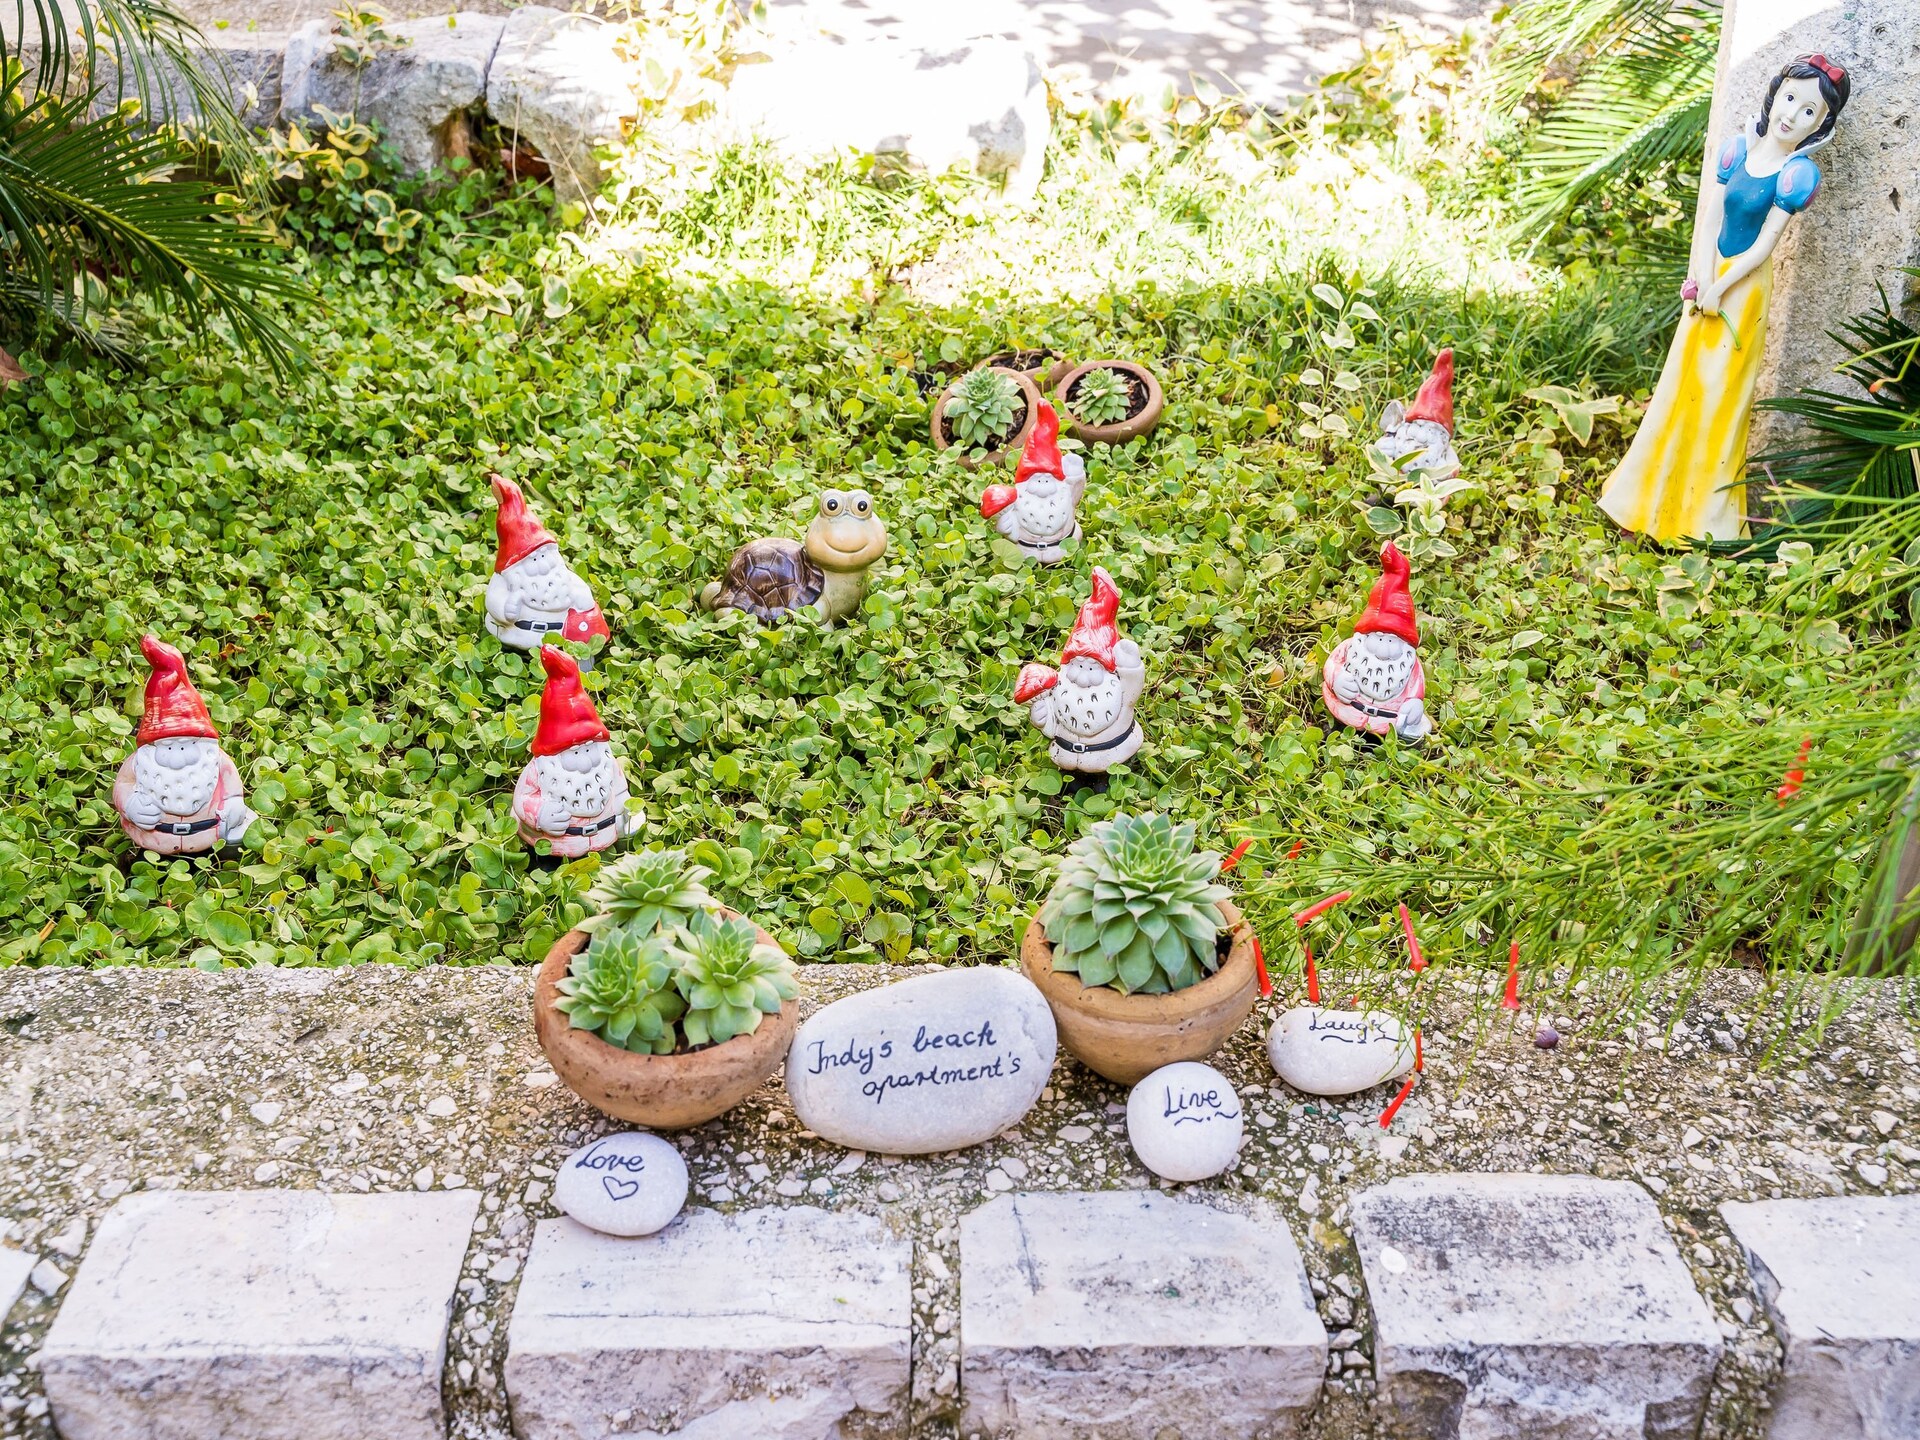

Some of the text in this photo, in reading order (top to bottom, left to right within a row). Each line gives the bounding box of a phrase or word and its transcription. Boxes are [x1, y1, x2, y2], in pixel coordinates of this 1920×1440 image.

[807, 1020, 997, 1075] Indy's beach
[862, 1051, 1021, 1104] apartment's
[1163, 1085, 1221, 1118] Live
[575, 1141, 645, 1173] Love
